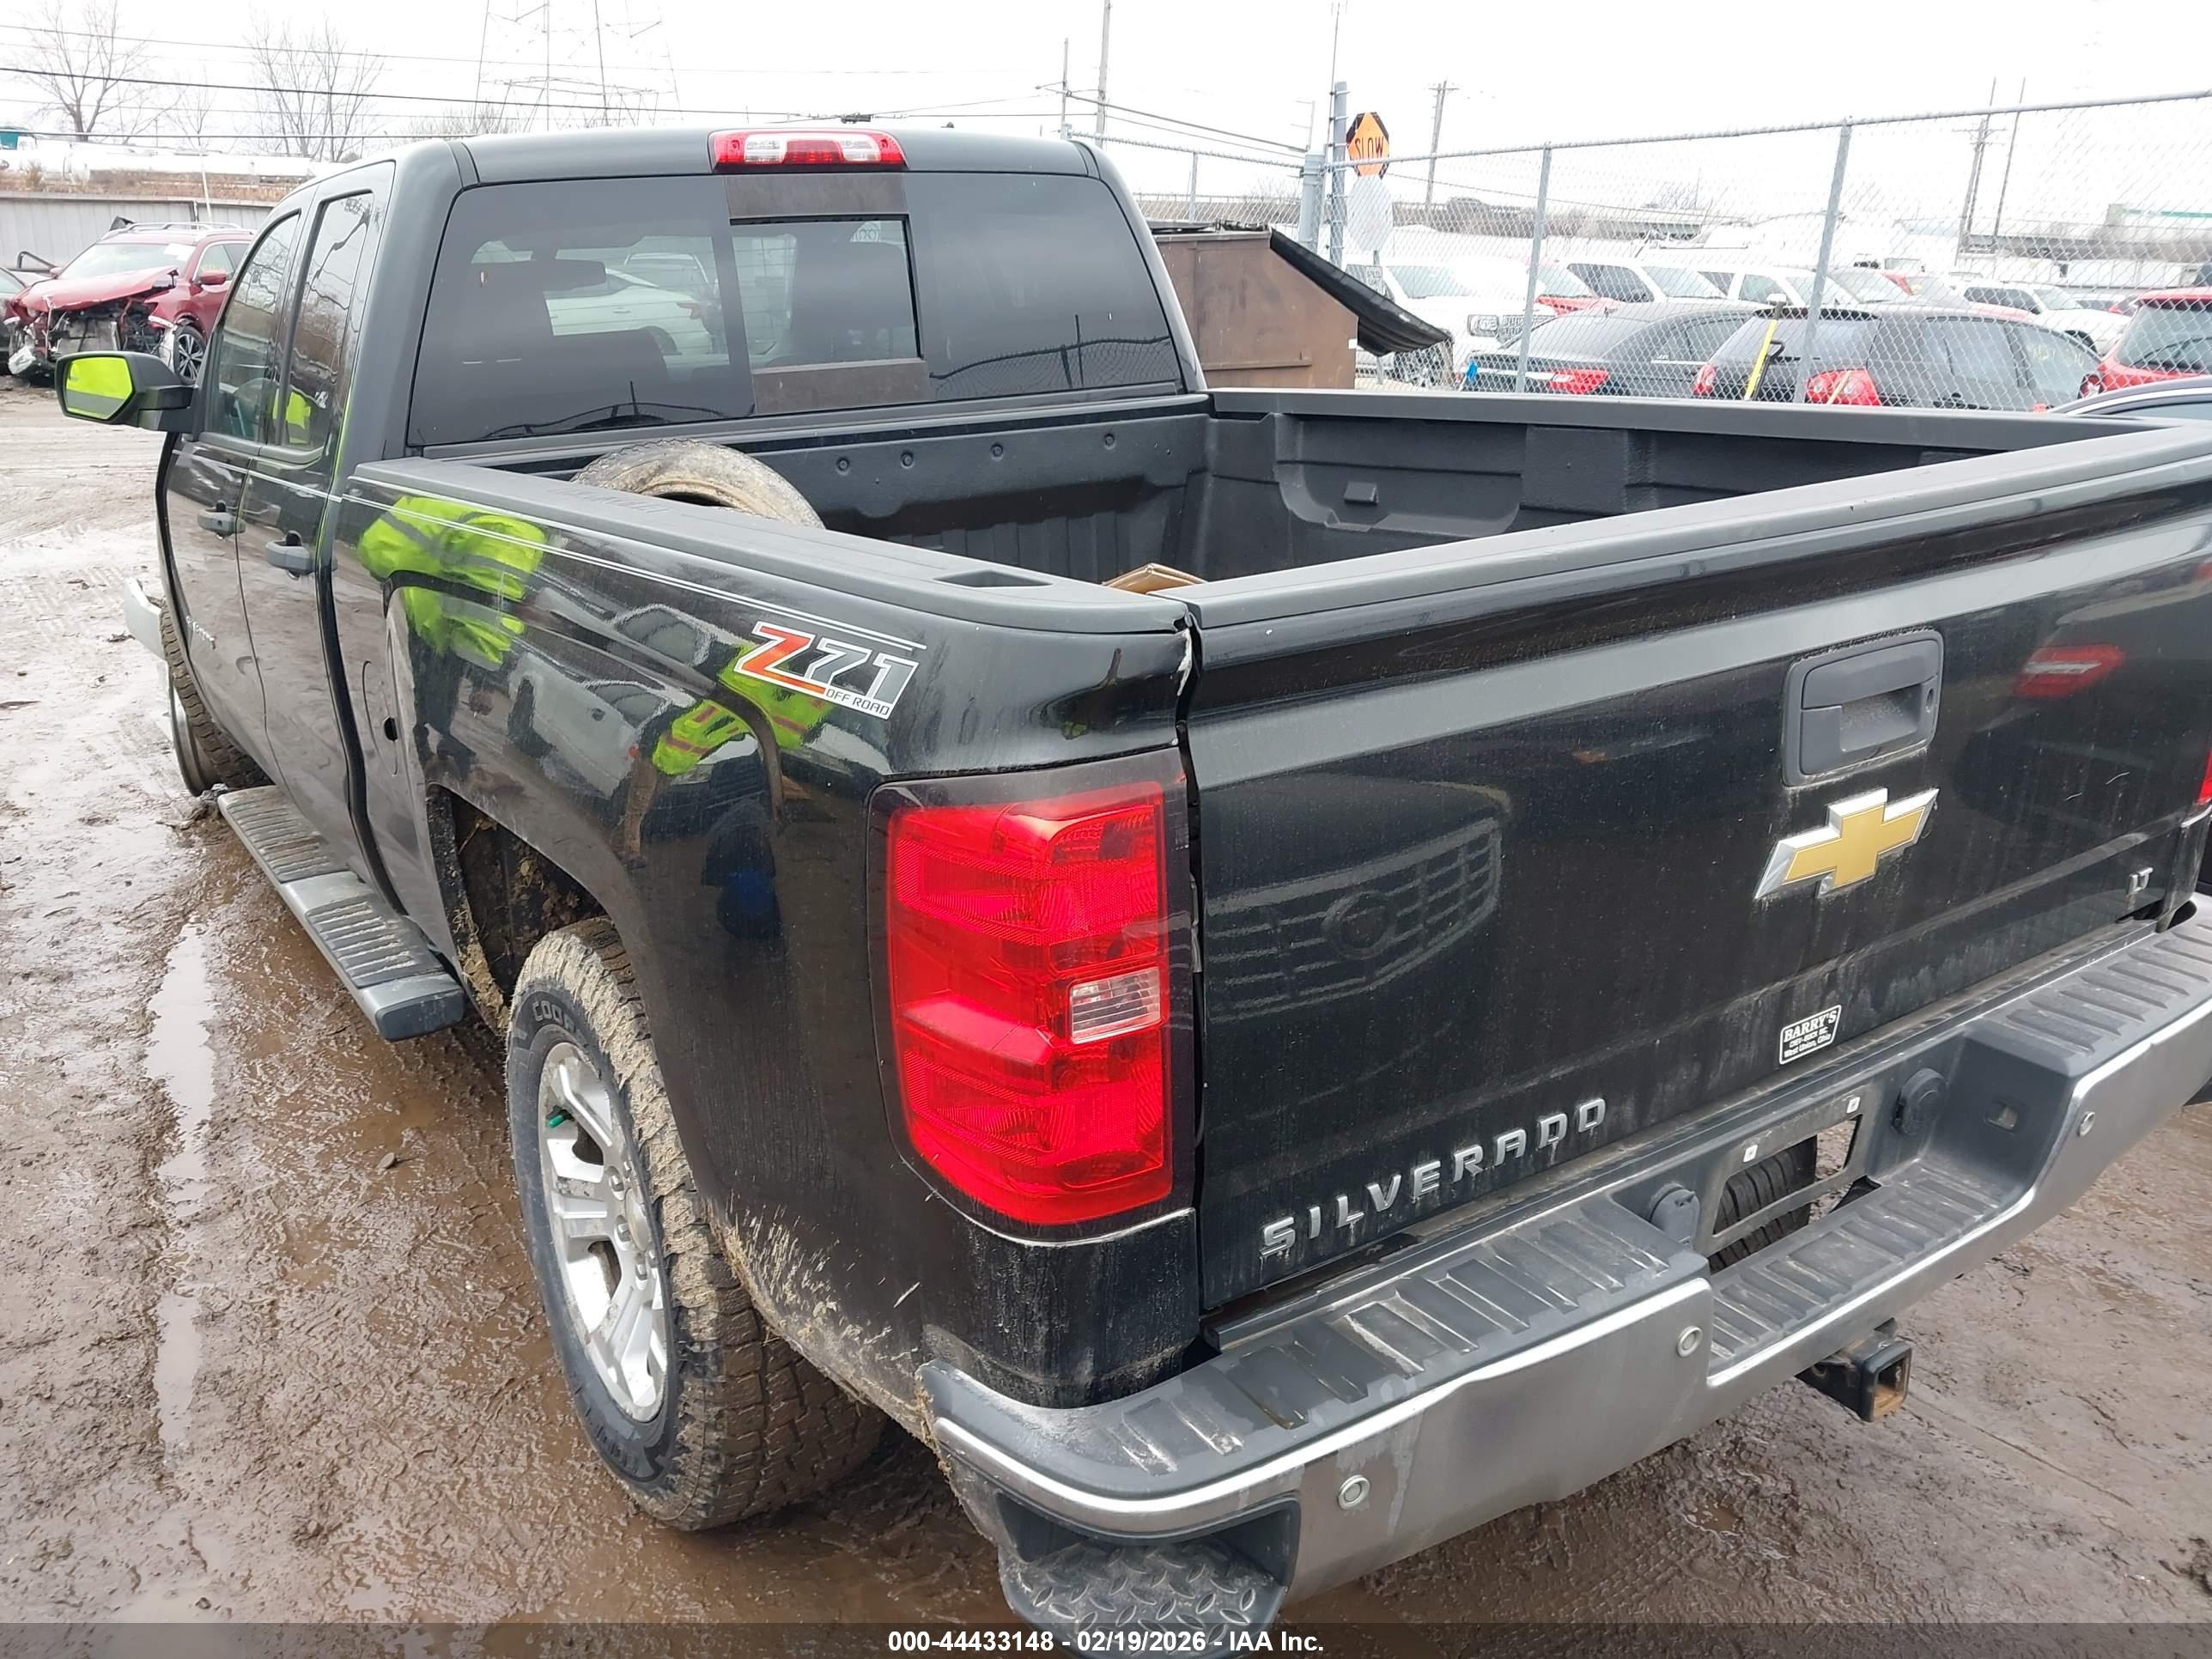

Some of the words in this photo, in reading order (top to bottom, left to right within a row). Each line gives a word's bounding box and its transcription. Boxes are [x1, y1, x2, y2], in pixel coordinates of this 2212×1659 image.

[1354, 137, 1384, 160] SLOW
[734, 621, 919, 705] Z71
[825, 686, 850, 702] OFF
[852, 696, 890, 716] ROAD
[2129, 866, 2154, 895] LT
[1784, 1010, 1838, 1043] BARRY'S
[1784, 1046, 1799, 1058] West
[1817, 1033, 1832, 1044] Ohio
[1260, 1098, 1606, 1257] SILVERADO
